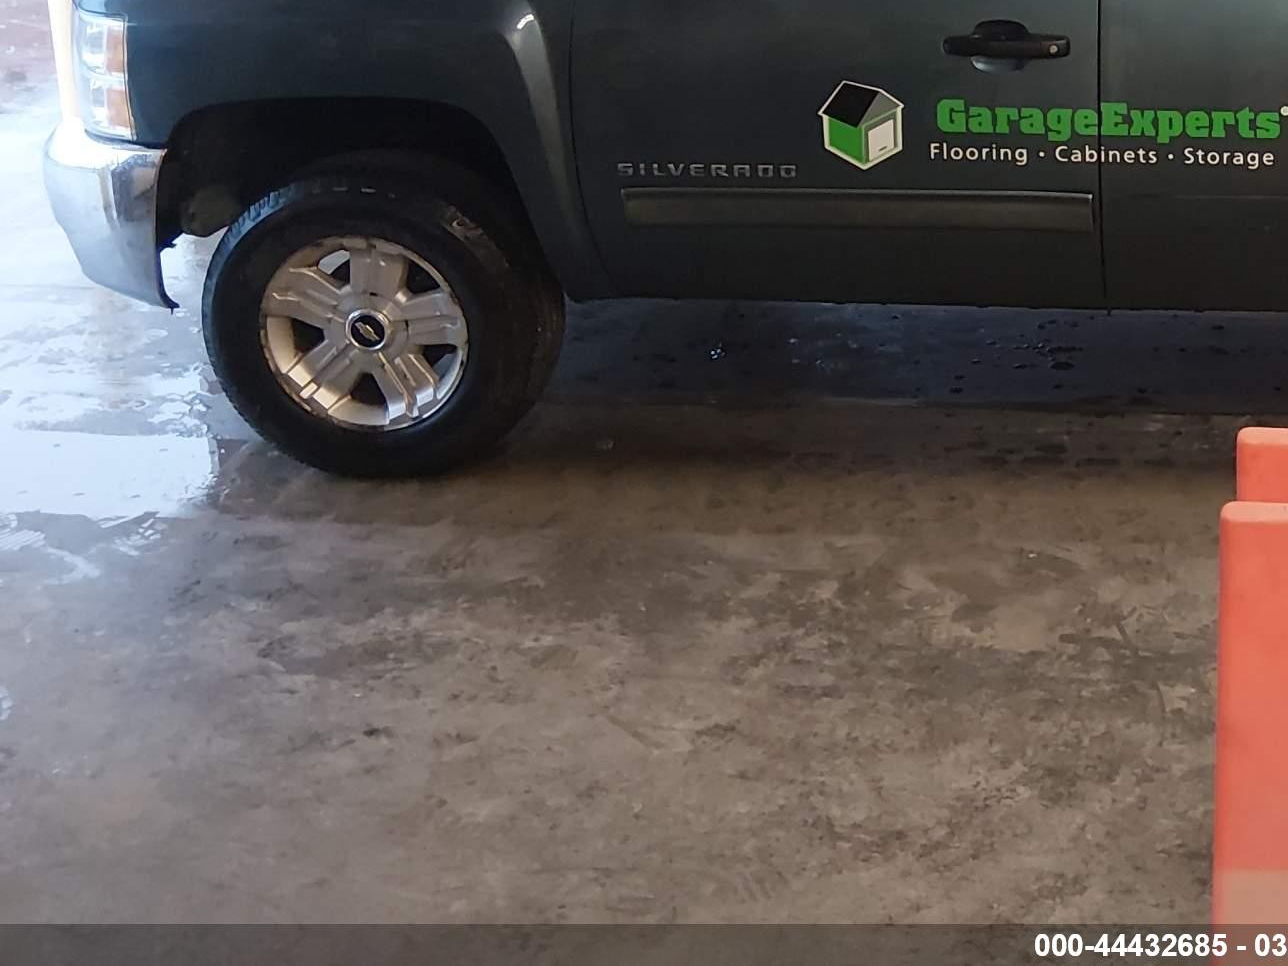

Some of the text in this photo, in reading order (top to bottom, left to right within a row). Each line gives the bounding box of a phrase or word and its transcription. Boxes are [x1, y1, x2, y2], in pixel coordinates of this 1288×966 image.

[929, 143, 1028, 165] Flooring
[1055, 146, 1158, 164] Cabinets
[1183, 148, 1275, 168] Storage
[617, 163, 797, 178] SILVERADO
